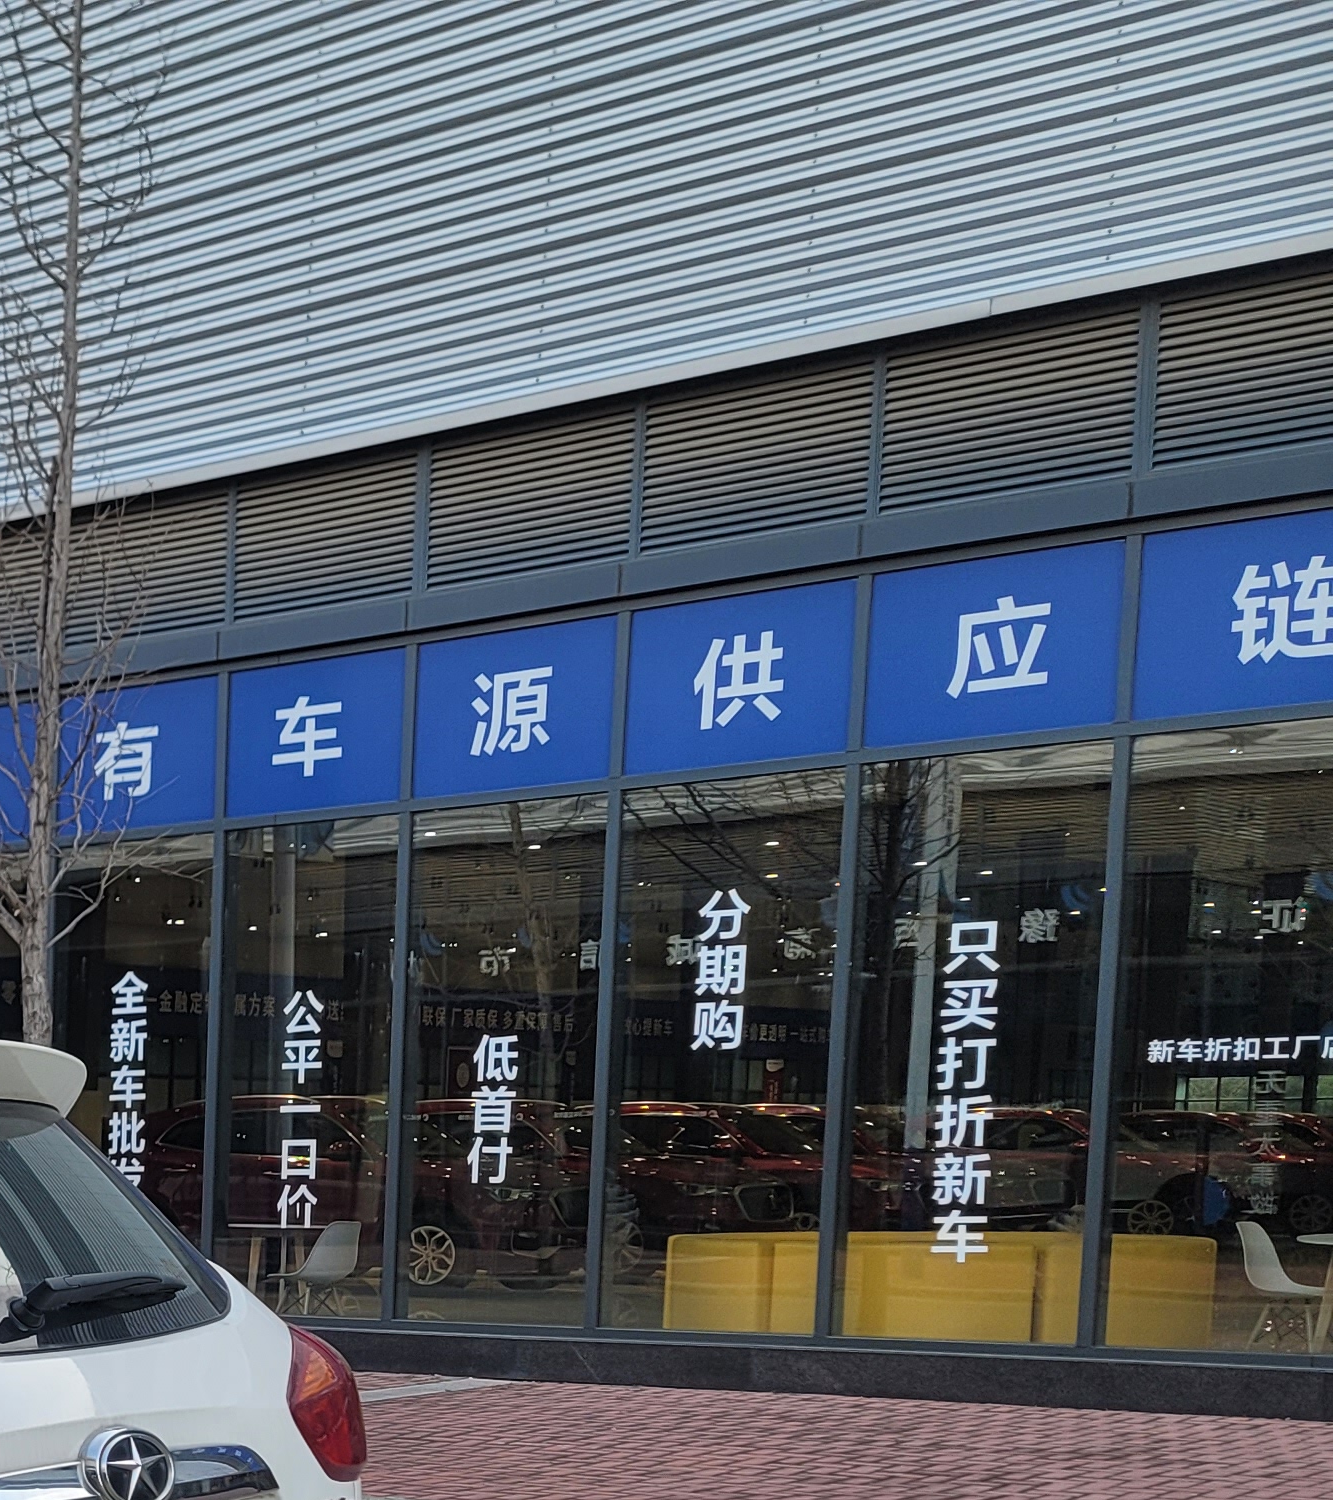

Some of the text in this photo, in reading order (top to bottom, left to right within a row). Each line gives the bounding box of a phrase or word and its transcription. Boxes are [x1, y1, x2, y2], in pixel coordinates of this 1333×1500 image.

[690, 888, 751, 1050] 分期购
[107, 971, 149, 1188] 全新车批发
[276, 988, 325, 1229] 公平一口价
[466, 1033, 519, 1185] 低首付
[930, 920, 1001, 1264] 只买打折新车
